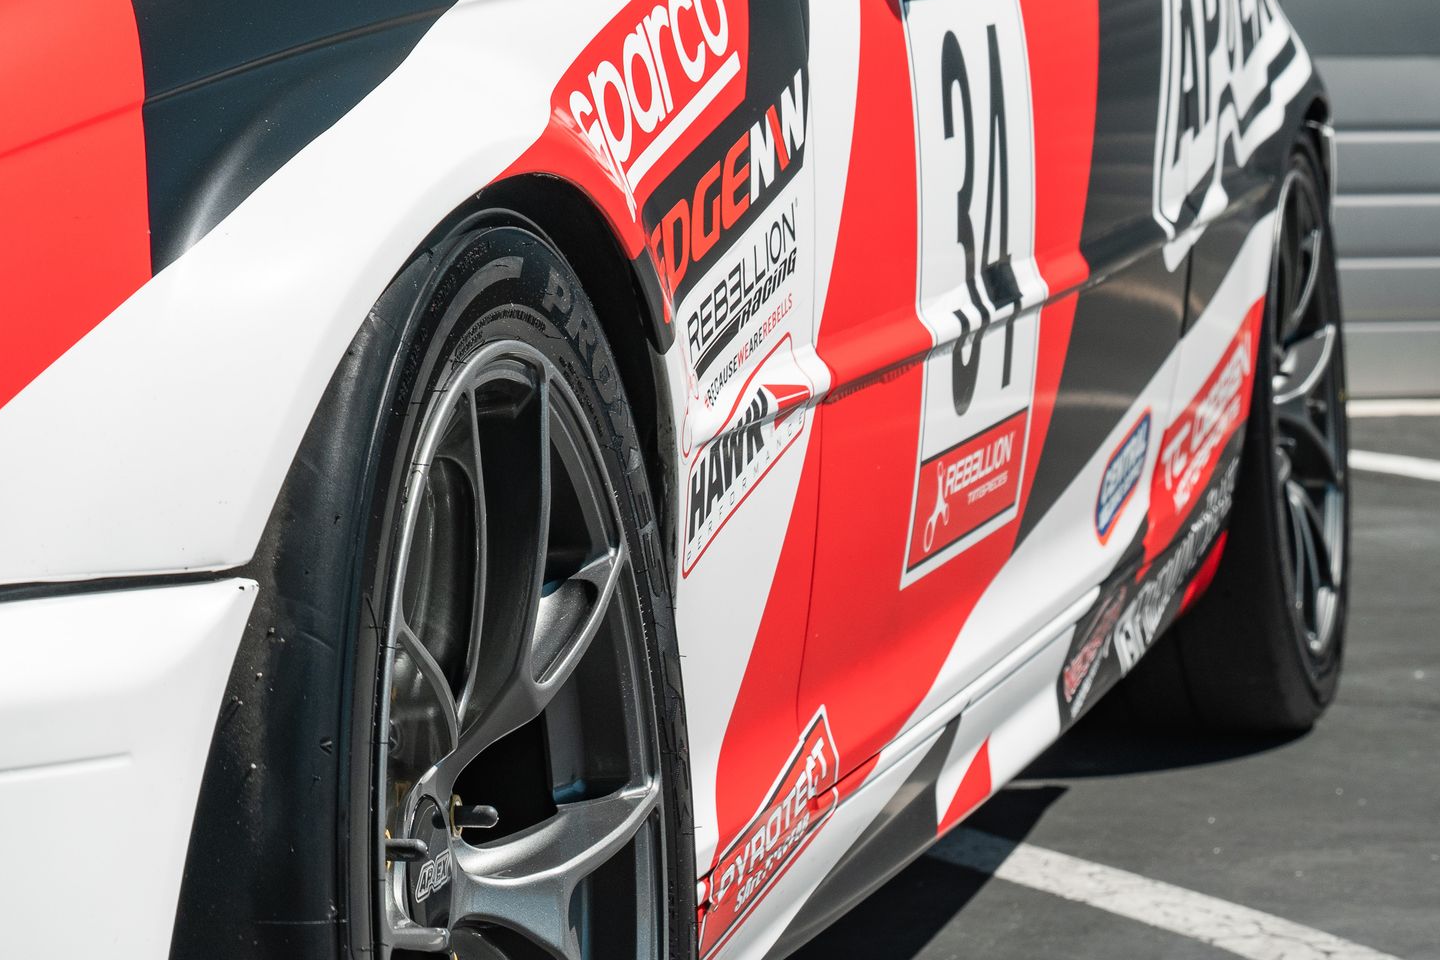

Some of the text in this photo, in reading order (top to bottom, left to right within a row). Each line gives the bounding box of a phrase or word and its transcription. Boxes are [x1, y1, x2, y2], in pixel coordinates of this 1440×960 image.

[937, 24, 1024, 416] 34
[688, 387, 769, 545] HAWK
[713, 737, 827, 912] PYROTECT
